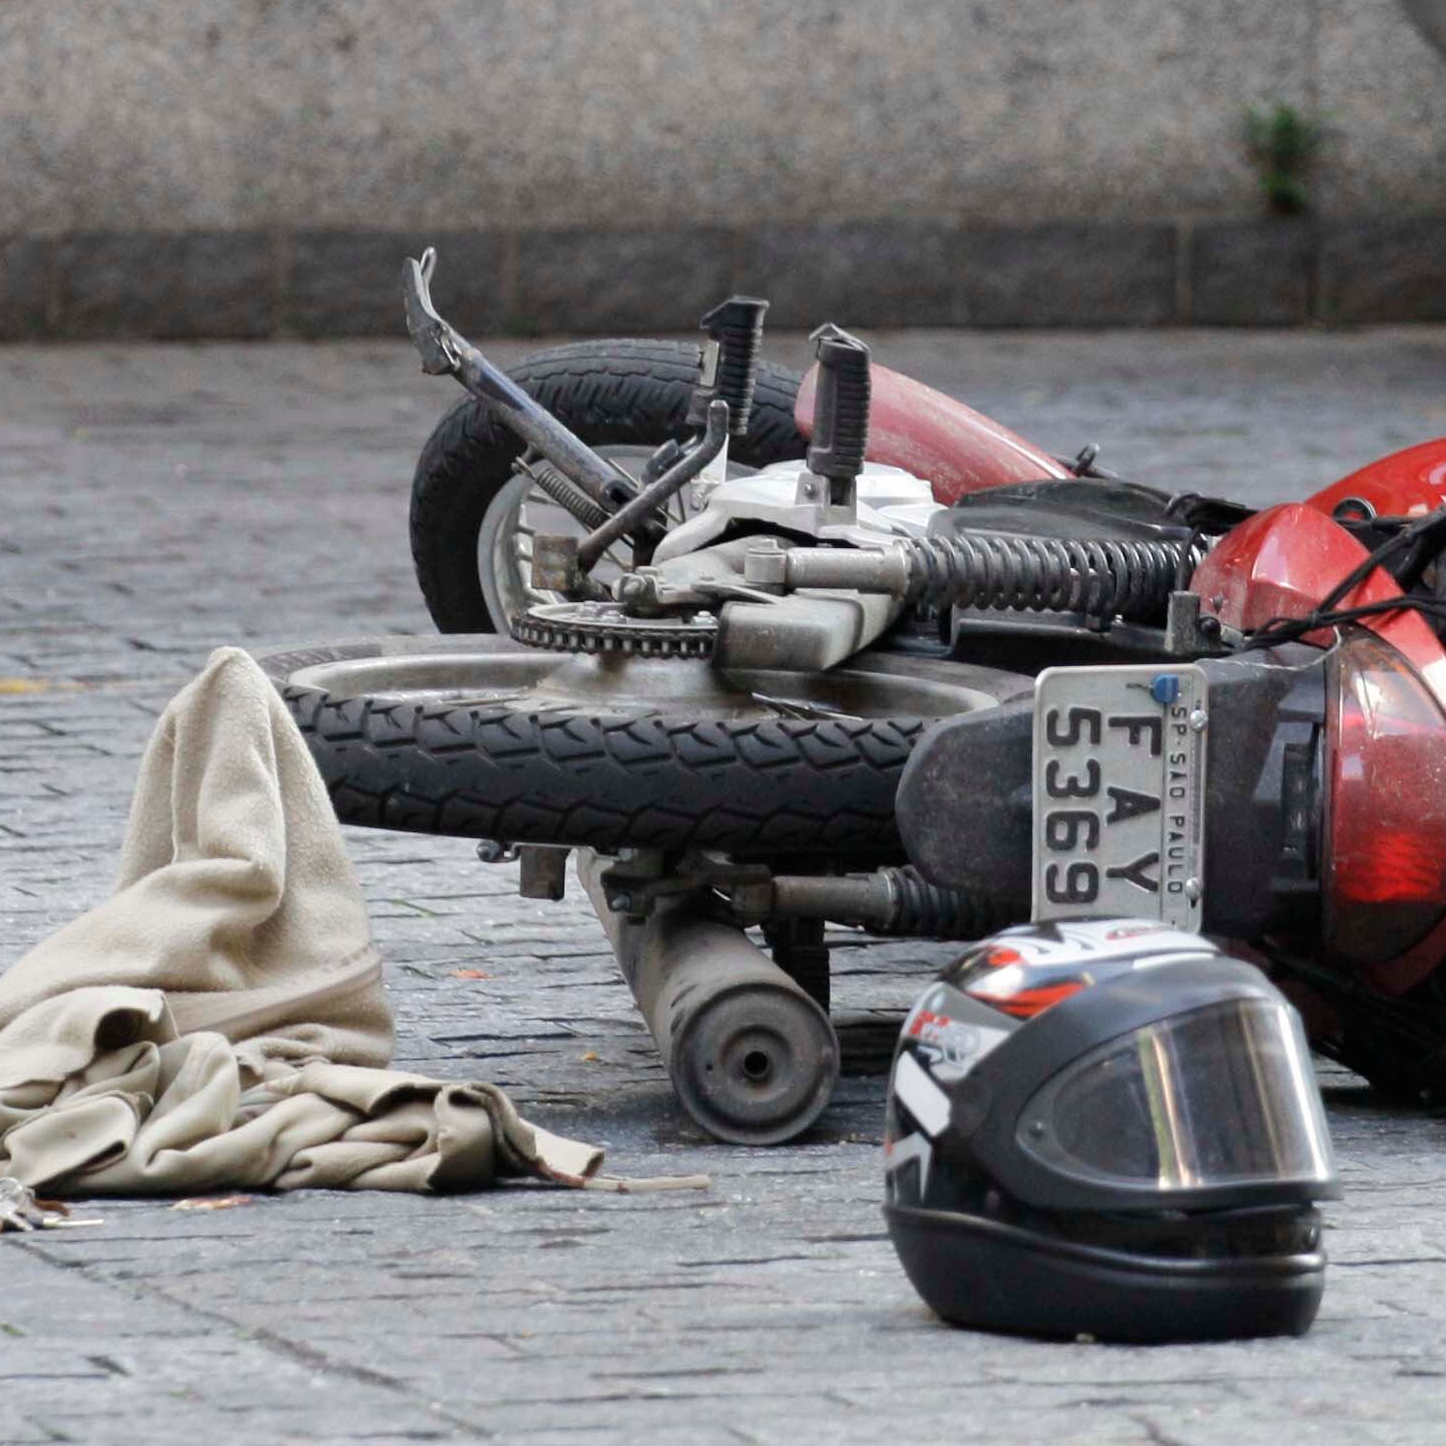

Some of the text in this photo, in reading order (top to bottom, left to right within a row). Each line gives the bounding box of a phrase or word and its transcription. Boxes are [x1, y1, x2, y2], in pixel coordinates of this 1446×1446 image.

[1046, 707, 1101, 904] 5369
[1106, 715, 1163, 892] FAY
[1168, 816, 1185, 893] PAULO
